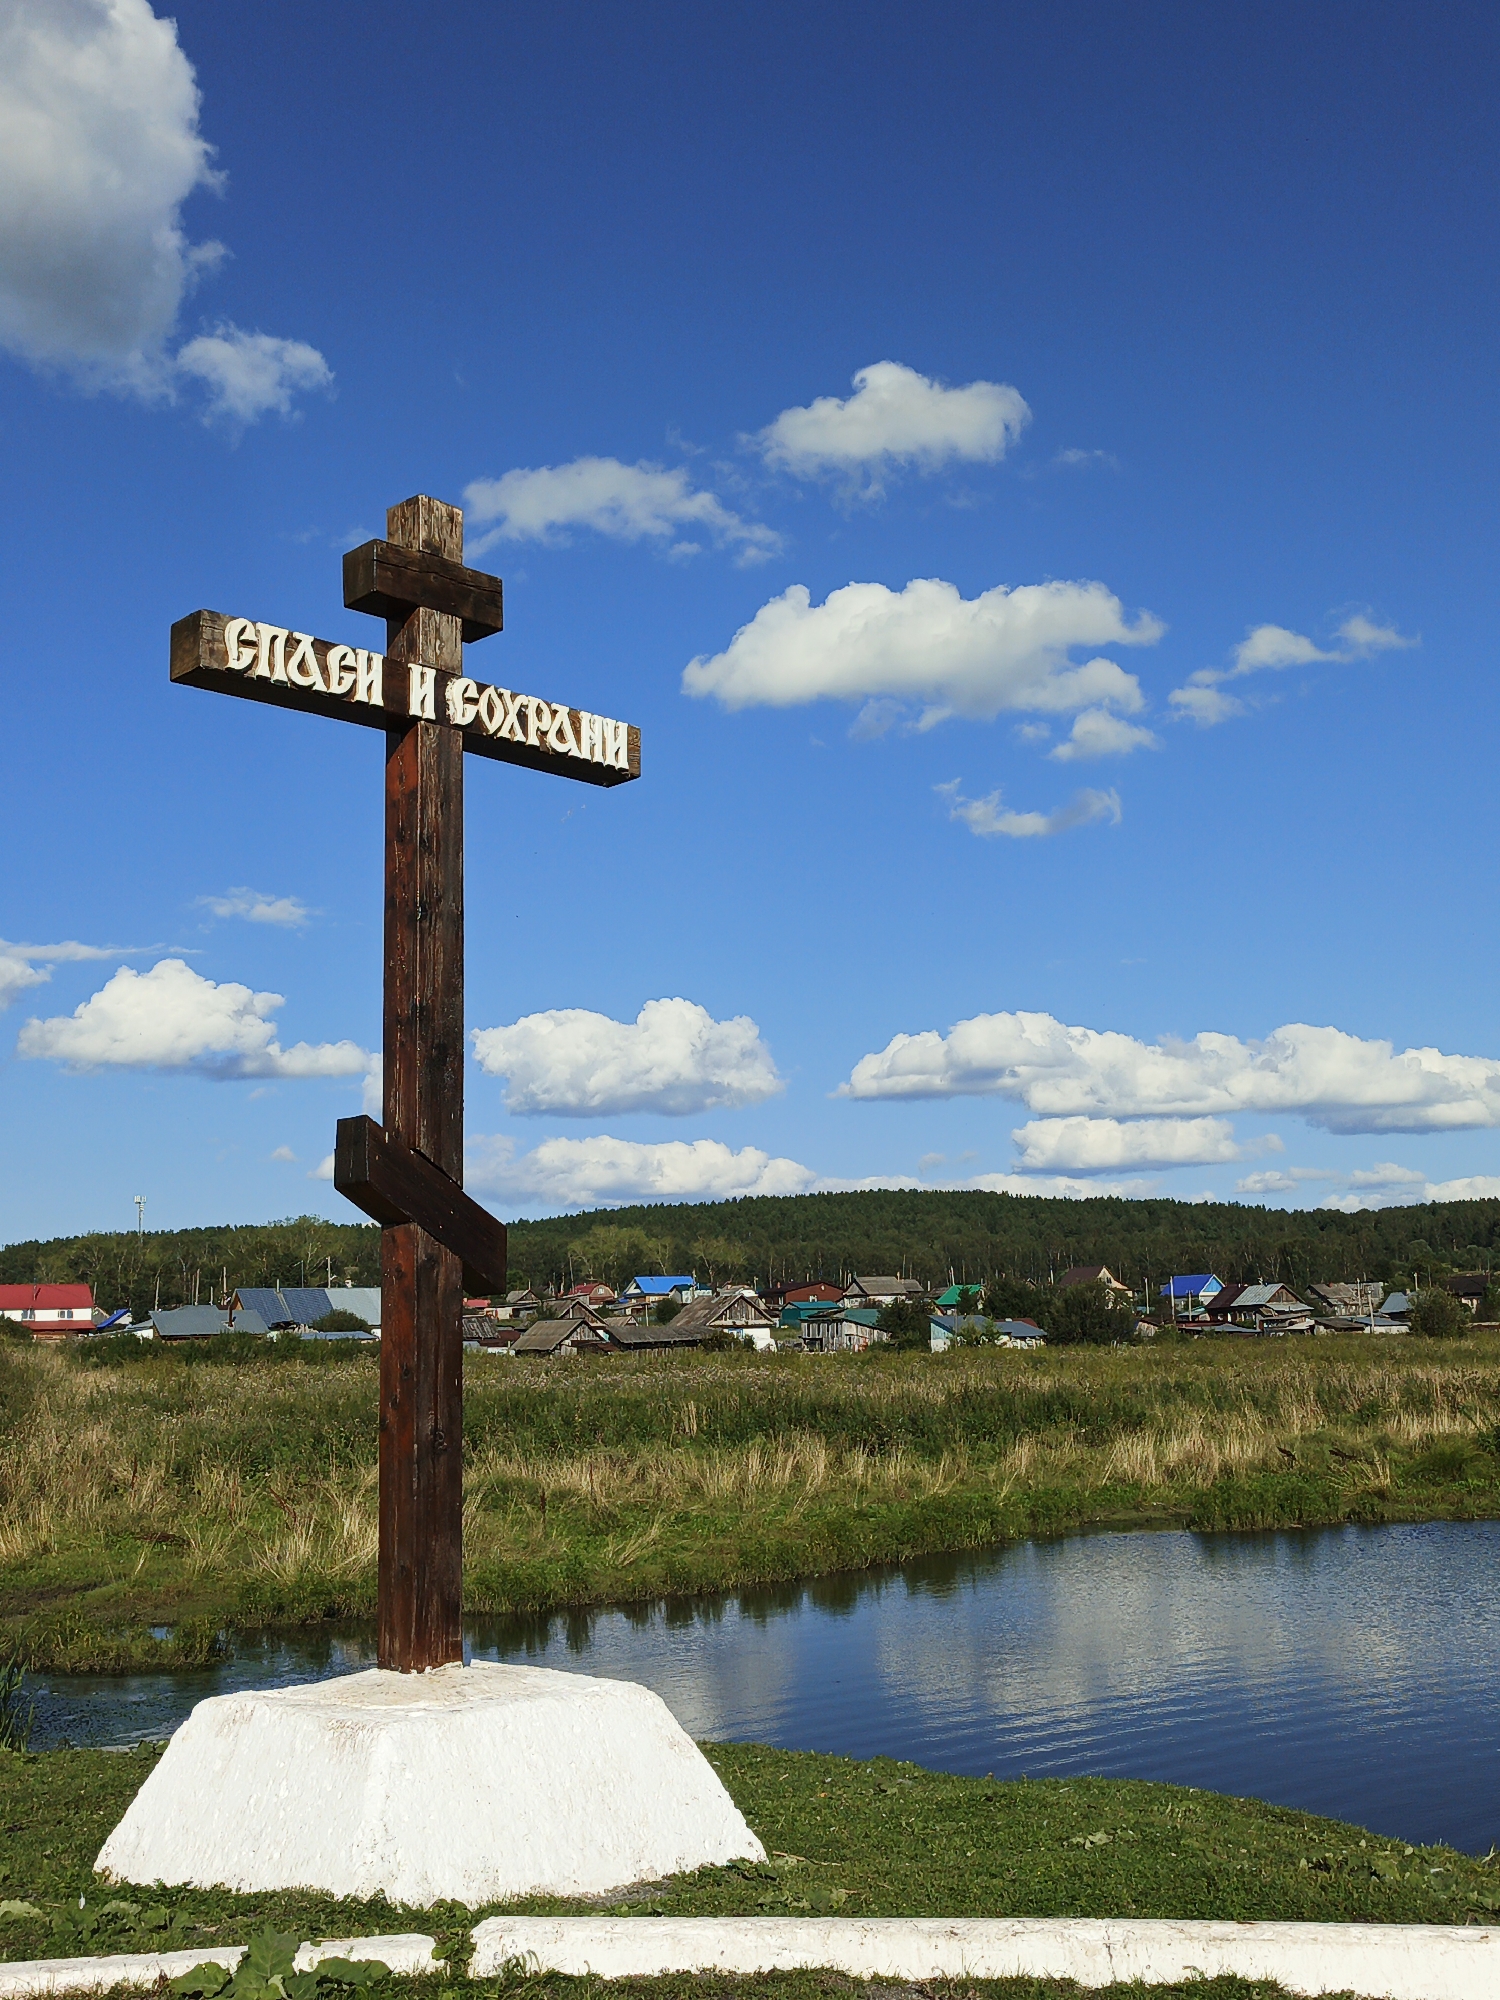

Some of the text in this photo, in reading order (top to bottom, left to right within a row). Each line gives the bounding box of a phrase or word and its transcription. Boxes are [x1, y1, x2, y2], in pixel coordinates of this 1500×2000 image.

[223, 617, 630, 770] СПАСИ И СОХРАНИ
